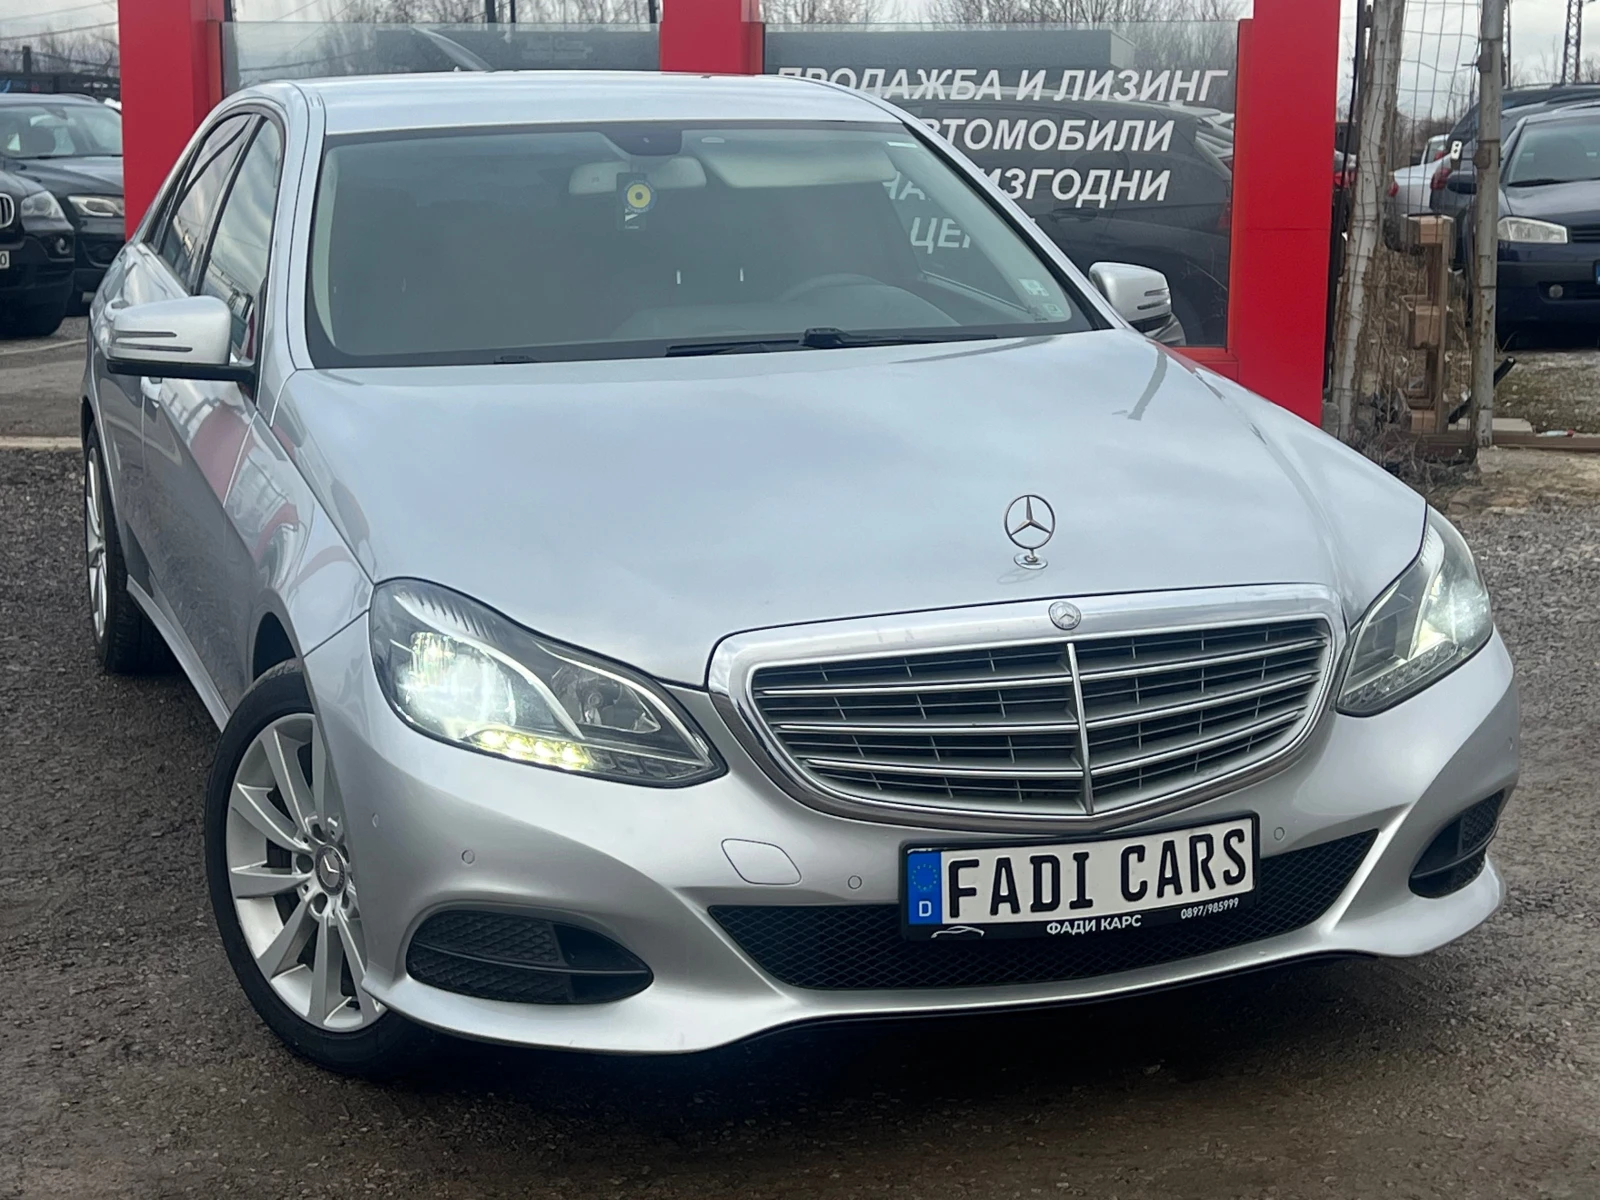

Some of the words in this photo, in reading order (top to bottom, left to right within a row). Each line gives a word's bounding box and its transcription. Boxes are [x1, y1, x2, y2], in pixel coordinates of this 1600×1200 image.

[1015, 69, 1046, 100] И
[1053, 69, 1229, 102] ЛИЗИНГ
[947, 851, 1094, 918] FADI
[1120, 828, 1247, 902] CARS
[918, 901, 932, 918] D
[1180, 897, 1239, 920] 0897/985999
[1046, 919, 1097, 936] ФАДИ
[1100, 914, 1142, 931] КАРС
